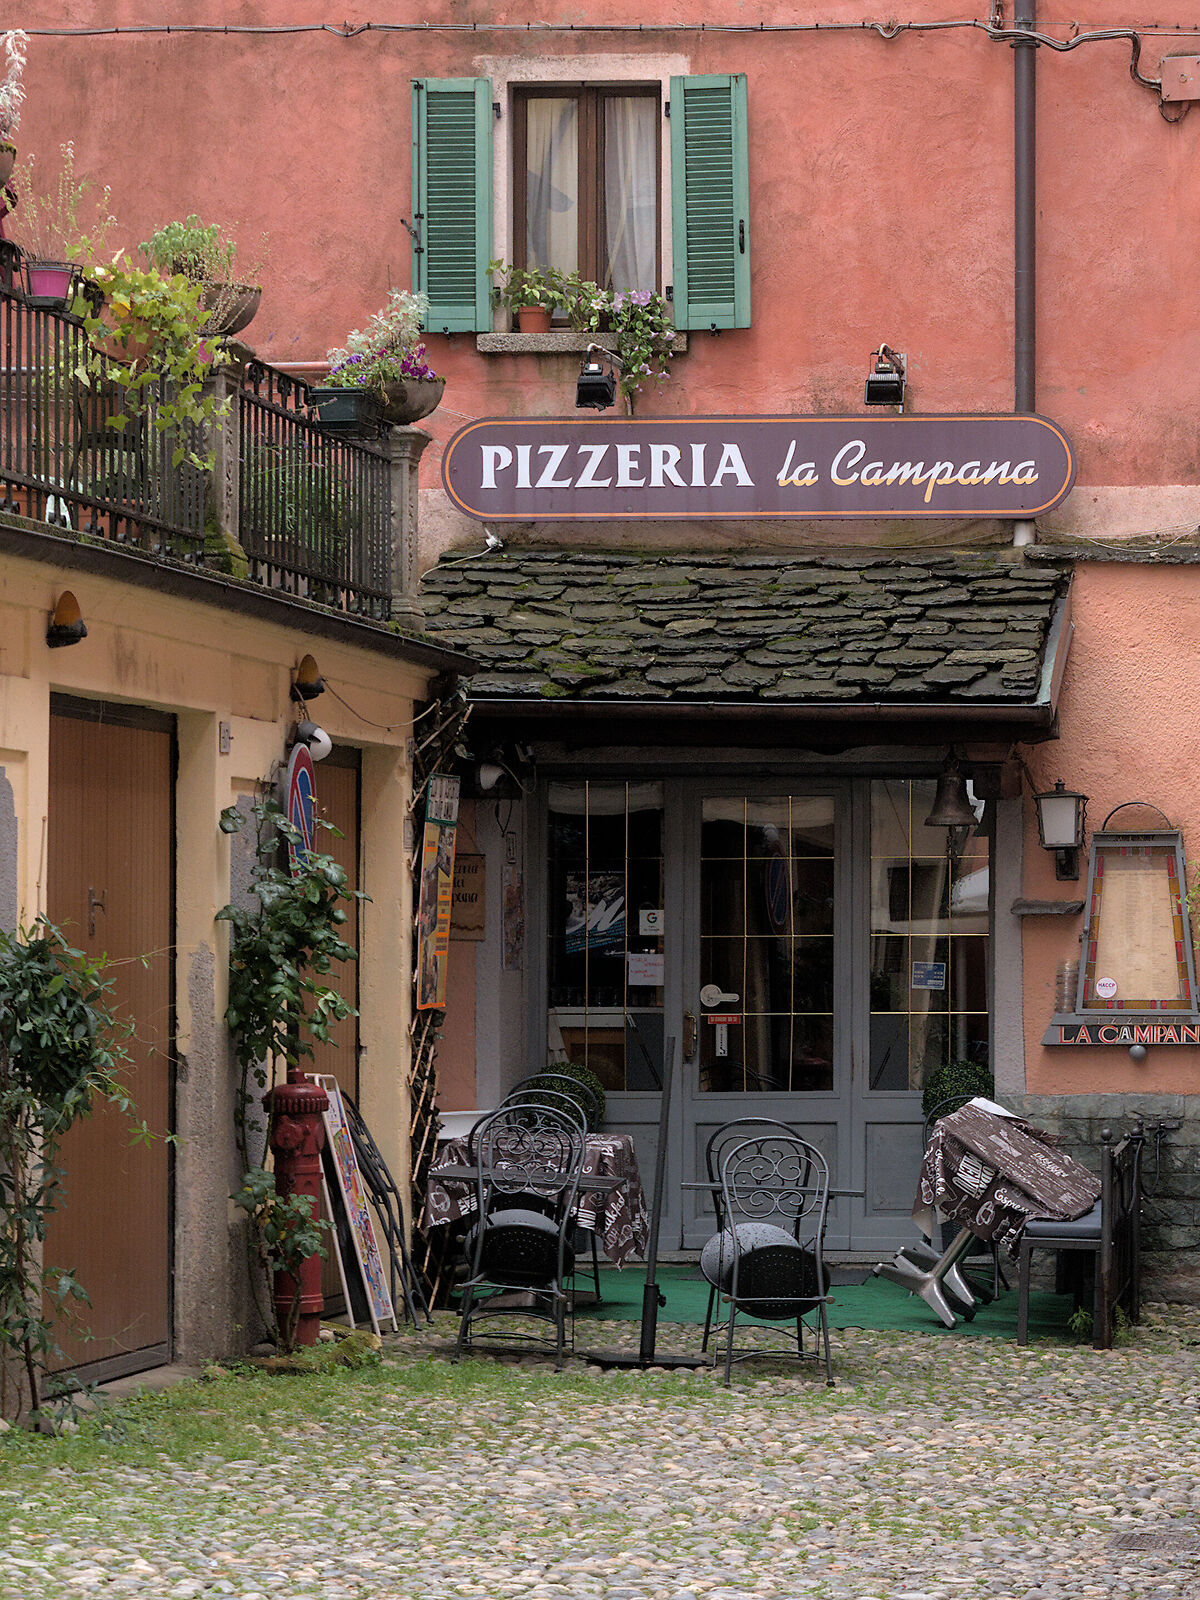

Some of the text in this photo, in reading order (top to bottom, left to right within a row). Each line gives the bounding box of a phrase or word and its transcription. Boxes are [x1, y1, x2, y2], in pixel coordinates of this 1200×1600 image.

[480, 439, 1039, 503] PIZZERIA la Campana
[1059, 1025, 1092, 1044] LA
[952, 1152, 983, 1199] MENU
